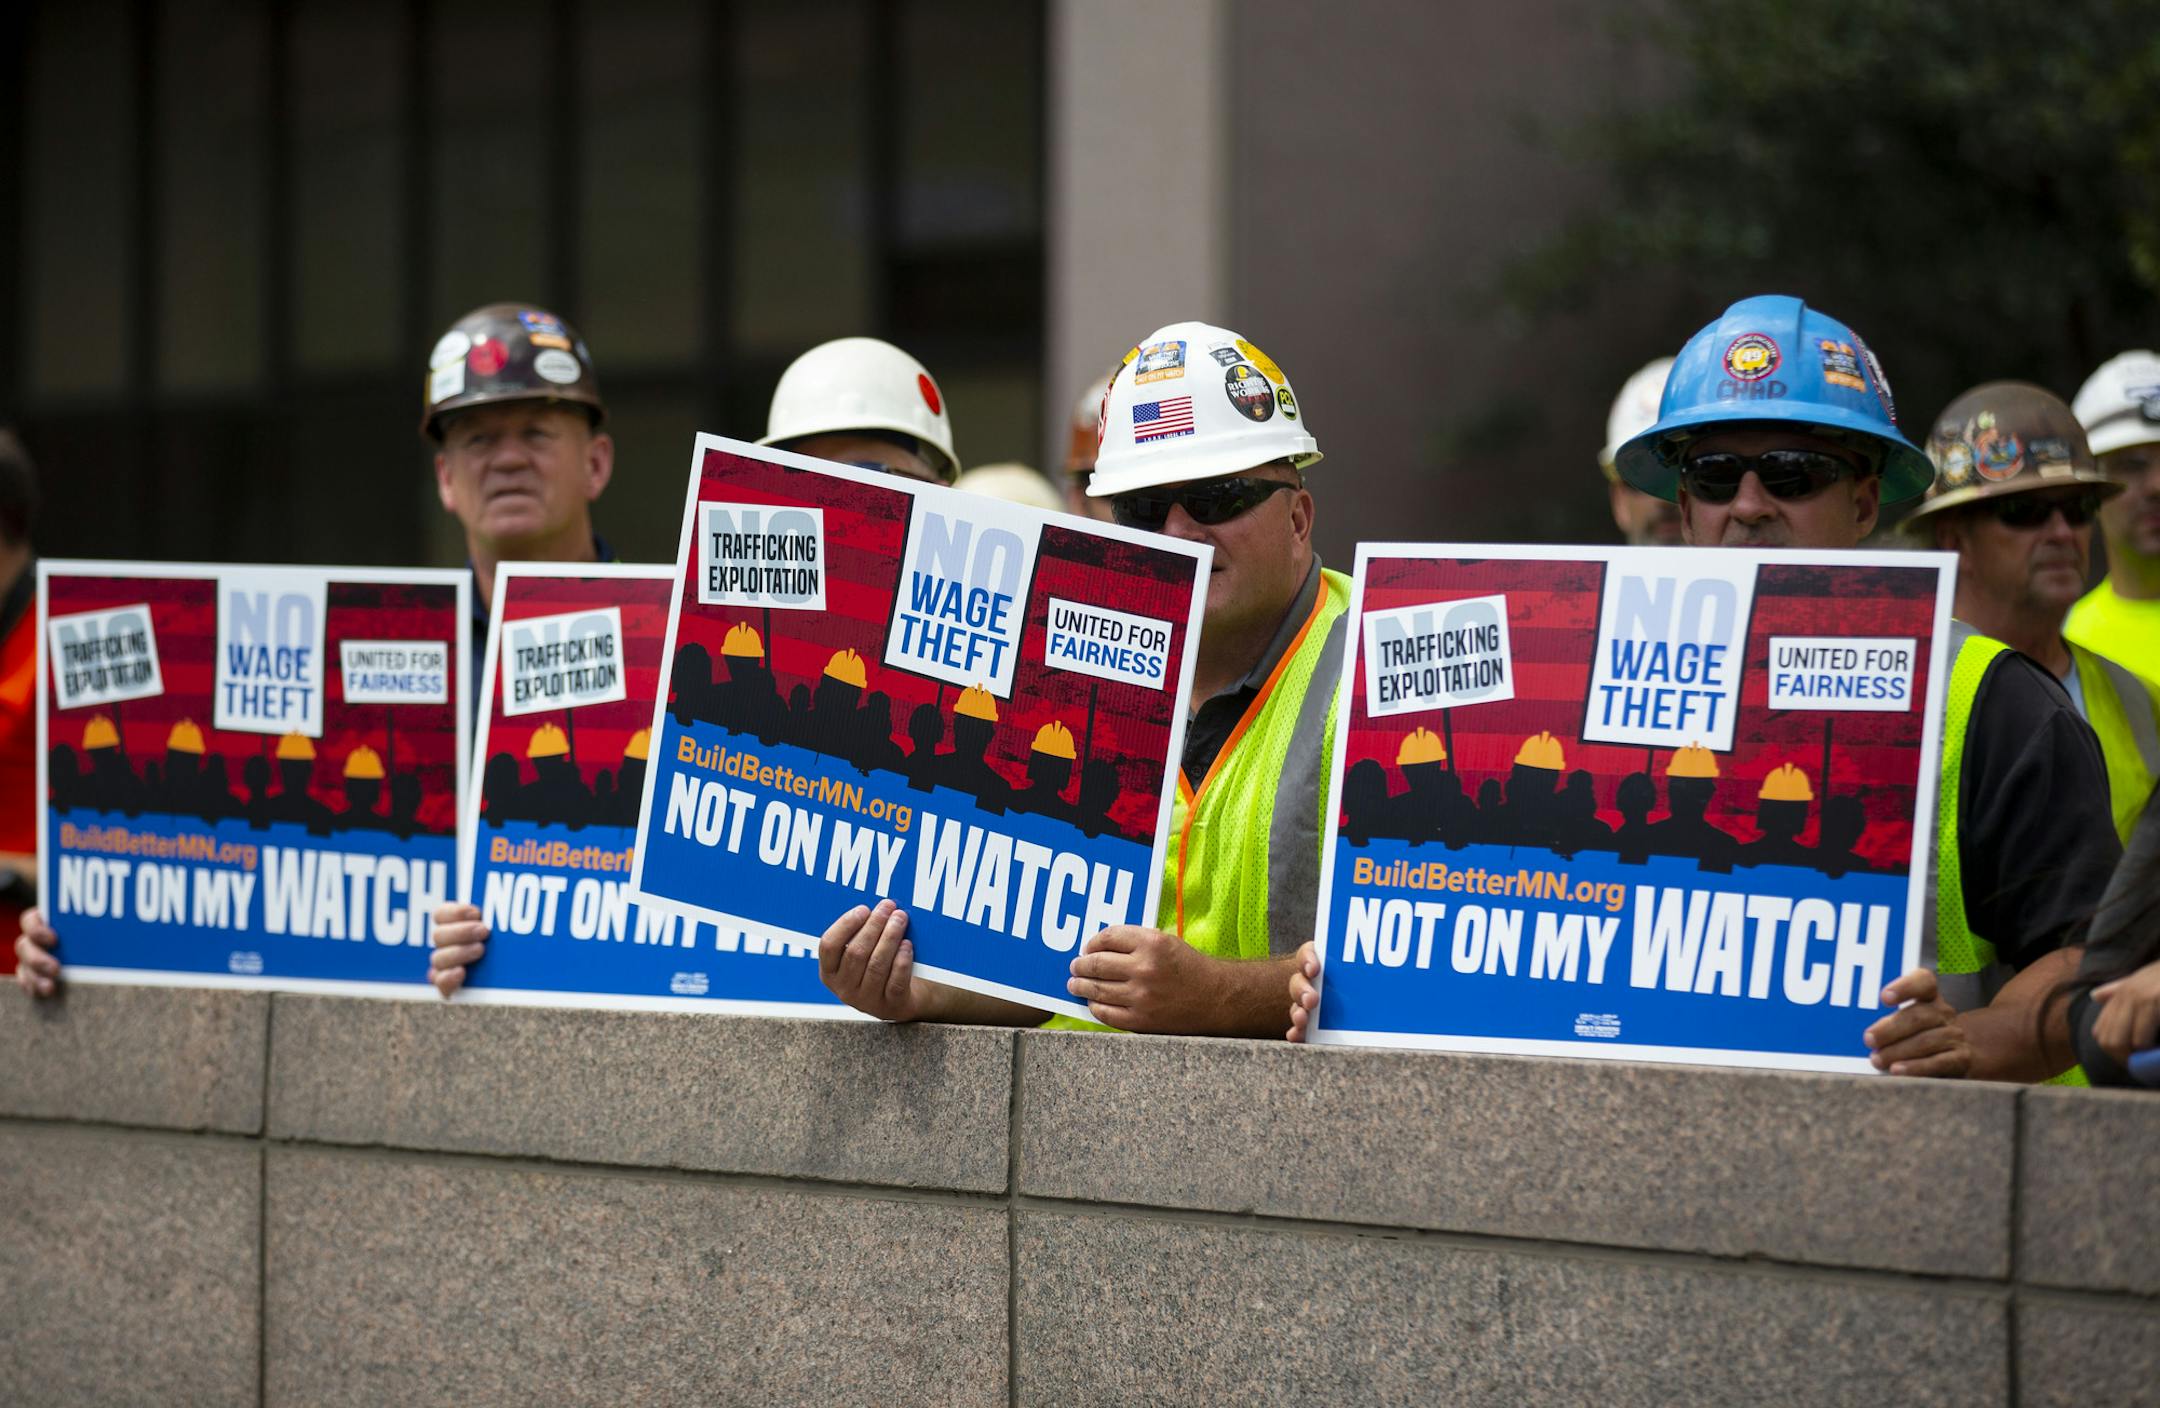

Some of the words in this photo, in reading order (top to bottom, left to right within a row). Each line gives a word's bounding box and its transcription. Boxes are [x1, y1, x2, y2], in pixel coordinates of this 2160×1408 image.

[1716, 379, 1788, 400] CHAD
[708, 510, 817, 604] NO
[713, 533, 816, 561] TRAFFICKING
[914, 512, 1024, 609] NO
[709, 566, 818, 595] EXPLOITATION
[911, 571, 1013, 635] WAGE
[229, 592, 314, 657] NO
[1055, 608, 1125, 641] UNITED
[1129, 623, 1166, 651] FOR
[1614, 576, 1737, 662] NO
[58, 613, 152, 699] NO
[63, 631, 147, 668] TRAFFICKING
[228, 643, 311, 682] WAGE
[348, 650, 406, 671] UNITED
[410, 651, 442, 671] FOR
[512, 615, 616, 706] NO
[517, 634, 613, 672] TRAFFICKING
[901, 614, 1009, 678] THEFT
[1049, 633, 1162, 678] FAIRNESS
[1376, 602, 1502, 711] NO
[1381, 624, 1499, 668] TRAFFICKING
[1612, 639, 1727, 686] WAGE
[1778, 647, 1857, 672] UNITED
[1865, 650, 1908, 672] FOR
[65, 661, 152, 698] EXPLOITATION
[224, 682, 313, 721] THEFT
[348, 674, 443, 695] FAIRNESS
[515, 664, 617, 702] EXPLOITATION
[1379, 658, 1504, 703] EXPLOITATION
[1774, 673, 1906, 701] FAIRNESS
[1600, 685, 1726, 733] THEFT
[677, 736, 912, 832] BuildBetterMN.org
[61, 824, 258, 870] BuildBetterMN.org
[664, 772, 756, 854] NOT
[759, 800, 824, 877] ON
[826, 818, 905, 898] MY
[912, 811, 1134, 953] WATCH
[59, 856, 131, 918] NOT
[135, 862, 187, 925] ON
[193, 866, 256, 930] MY
[262, 845, 447, 948] WATCH
[483, 871, 567, 937] NOT
[569, 878, 632, 942] ON
[1353, 858, 1625, 912] BuildBetterMN.org
[1342, 897, 1445, 969] NOT
[1451, 905, 1524, 976] ON
[1529, 911, 1621, 985] MY
[1630, 886, 1891, 1010] WATCH
